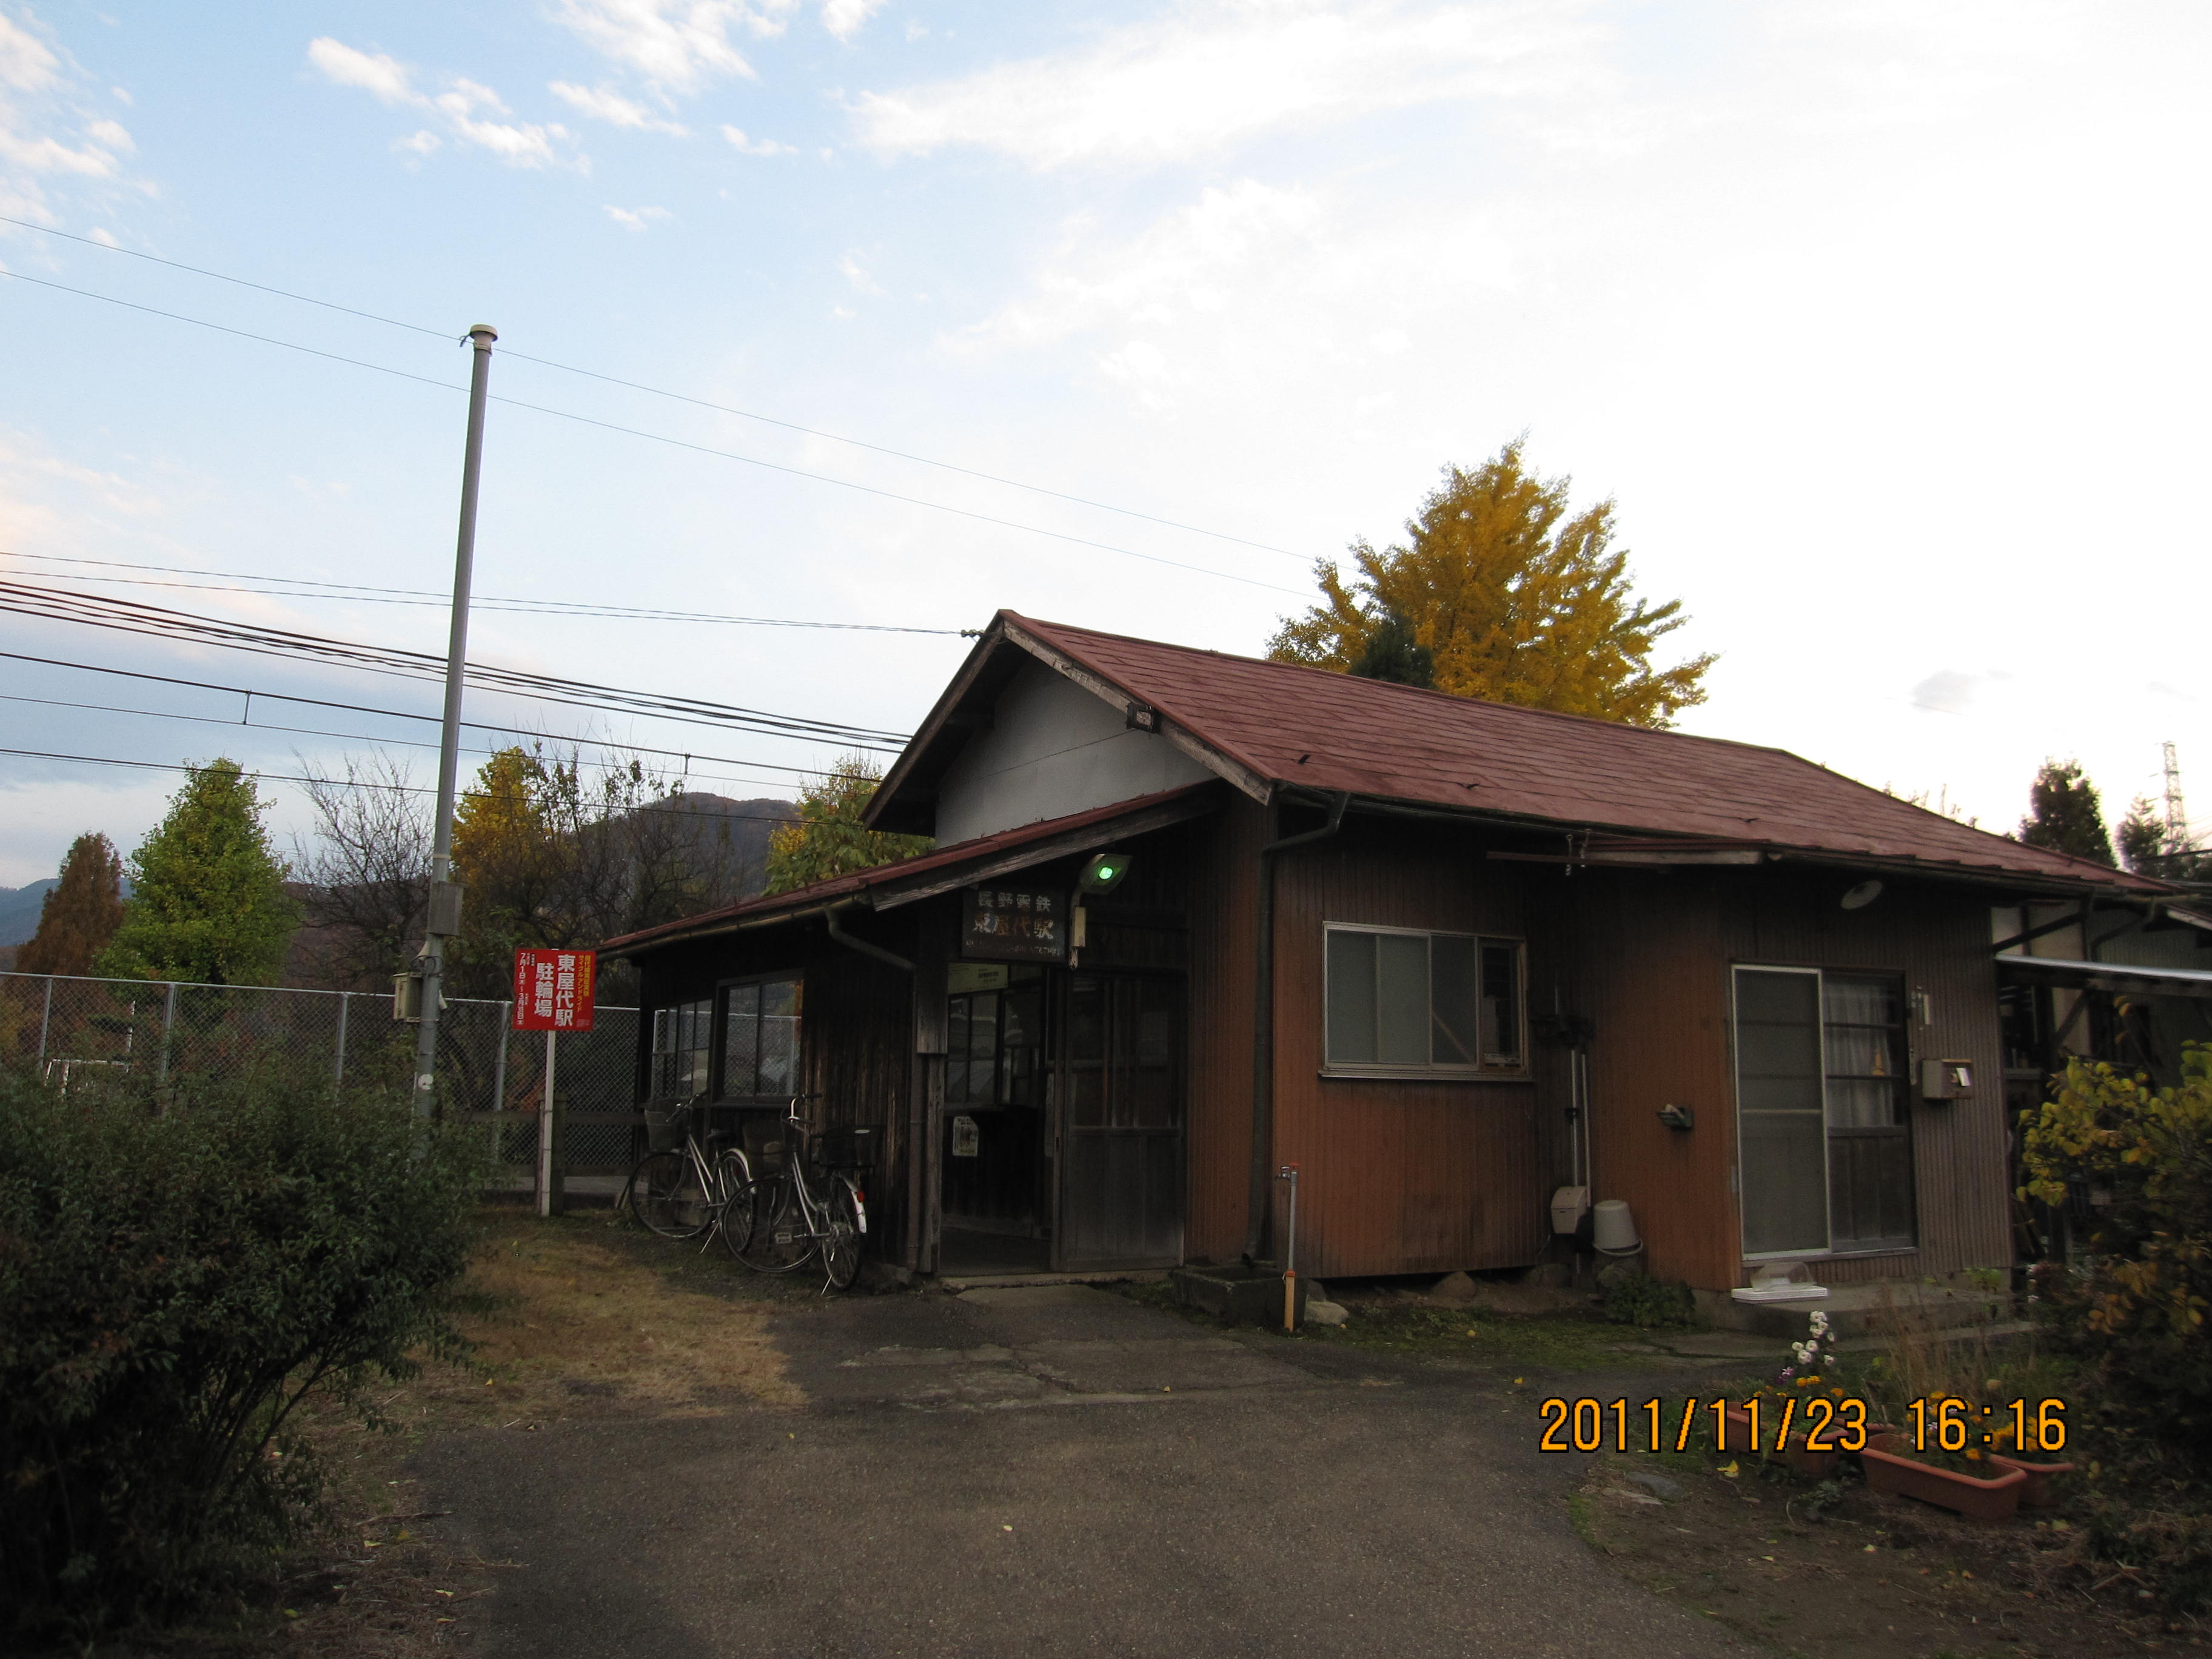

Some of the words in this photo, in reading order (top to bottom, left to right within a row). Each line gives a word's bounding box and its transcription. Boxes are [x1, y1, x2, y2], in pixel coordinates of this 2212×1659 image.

[534, 962, 555, 1017] 駐輪場
[555, 954, 575, 1027] 東屋代駅
